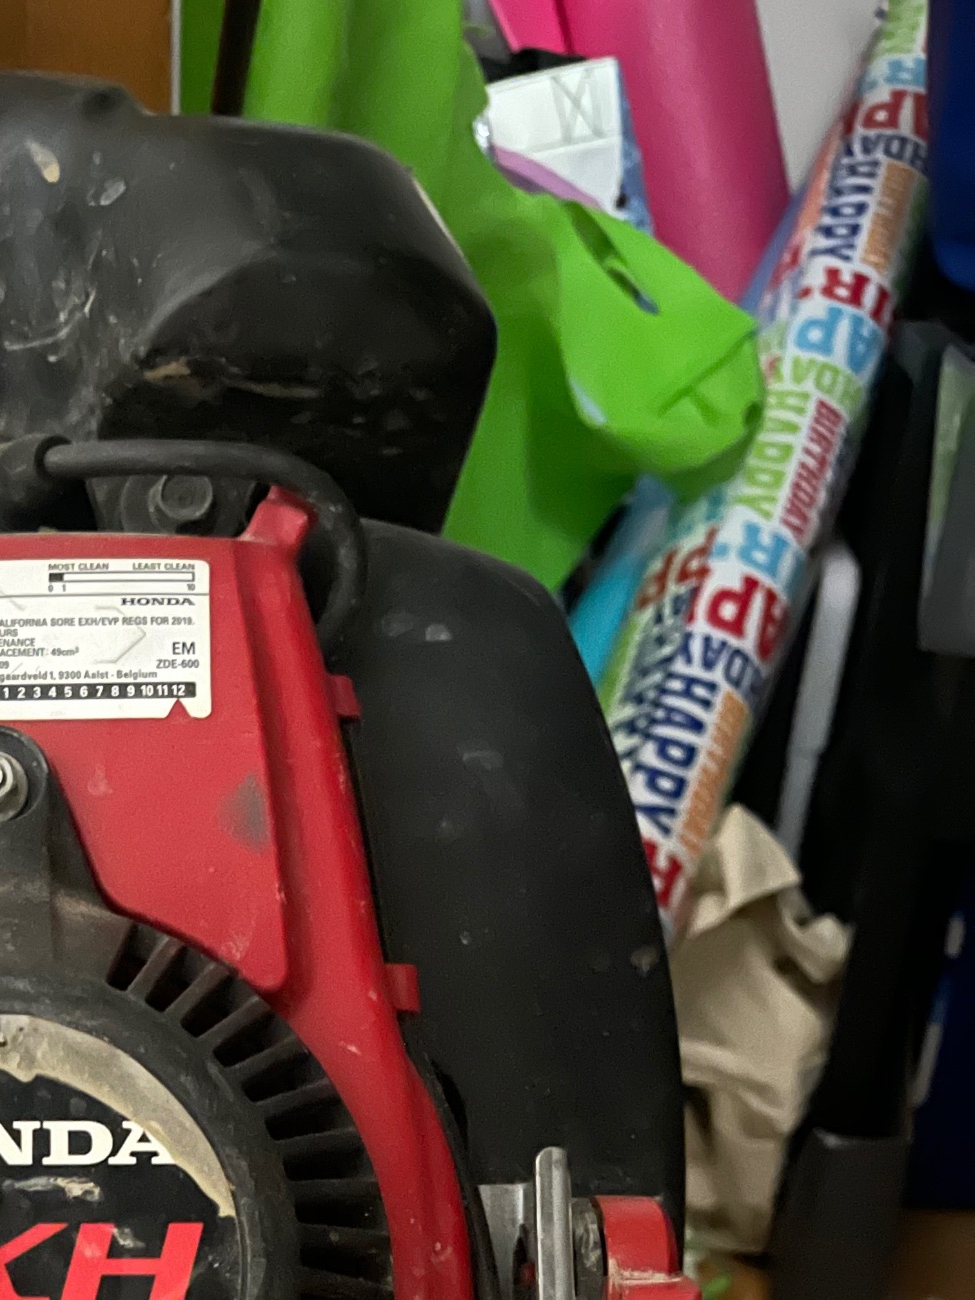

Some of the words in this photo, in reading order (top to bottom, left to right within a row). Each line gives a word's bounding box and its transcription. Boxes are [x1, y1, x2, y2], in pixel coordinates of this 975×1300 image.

[78, 562, 109, 571] CLEAN
[132, 562, 162, 570] LEAST
[48, 584, 54, 592] 0
[62, 584, 66, 592] 1
[187, 583, 195, 591] 10
[121, 598, 195, 606] HONDA
[50, 618, 75, 626] SORE
[78, 617, 119, 626] EXH/EVP
[122, 616, 147, 625] REGS
[150, 616, 169, 625] FOR
[172, 642, 196, 655] EM
[156, 659, 200, 669] ZDE-600
[58, 671, 81, 680] 9300
[84, 670, 109, 679] Aalst
[116, 669, 157, 681] Belgium
[3, 687, 9, 699] 1
[17, 686, 26, 699] 2
[33, 686, 41, 698] 3
[48, 686, 57, 698] 4
[64, 686, 72, 698] 5
[79, 686, 88, 697] 6
[96, 685, 104, 697] 7
[111, 685, 120, 697] 8
[126, 685, 135, 697] 9
[140, 685, 154, 696] 10
[156, 684, 168, 696] 11
[171, 684, 185, 696] 12
[633, 672, 719, 836] HAPPY
